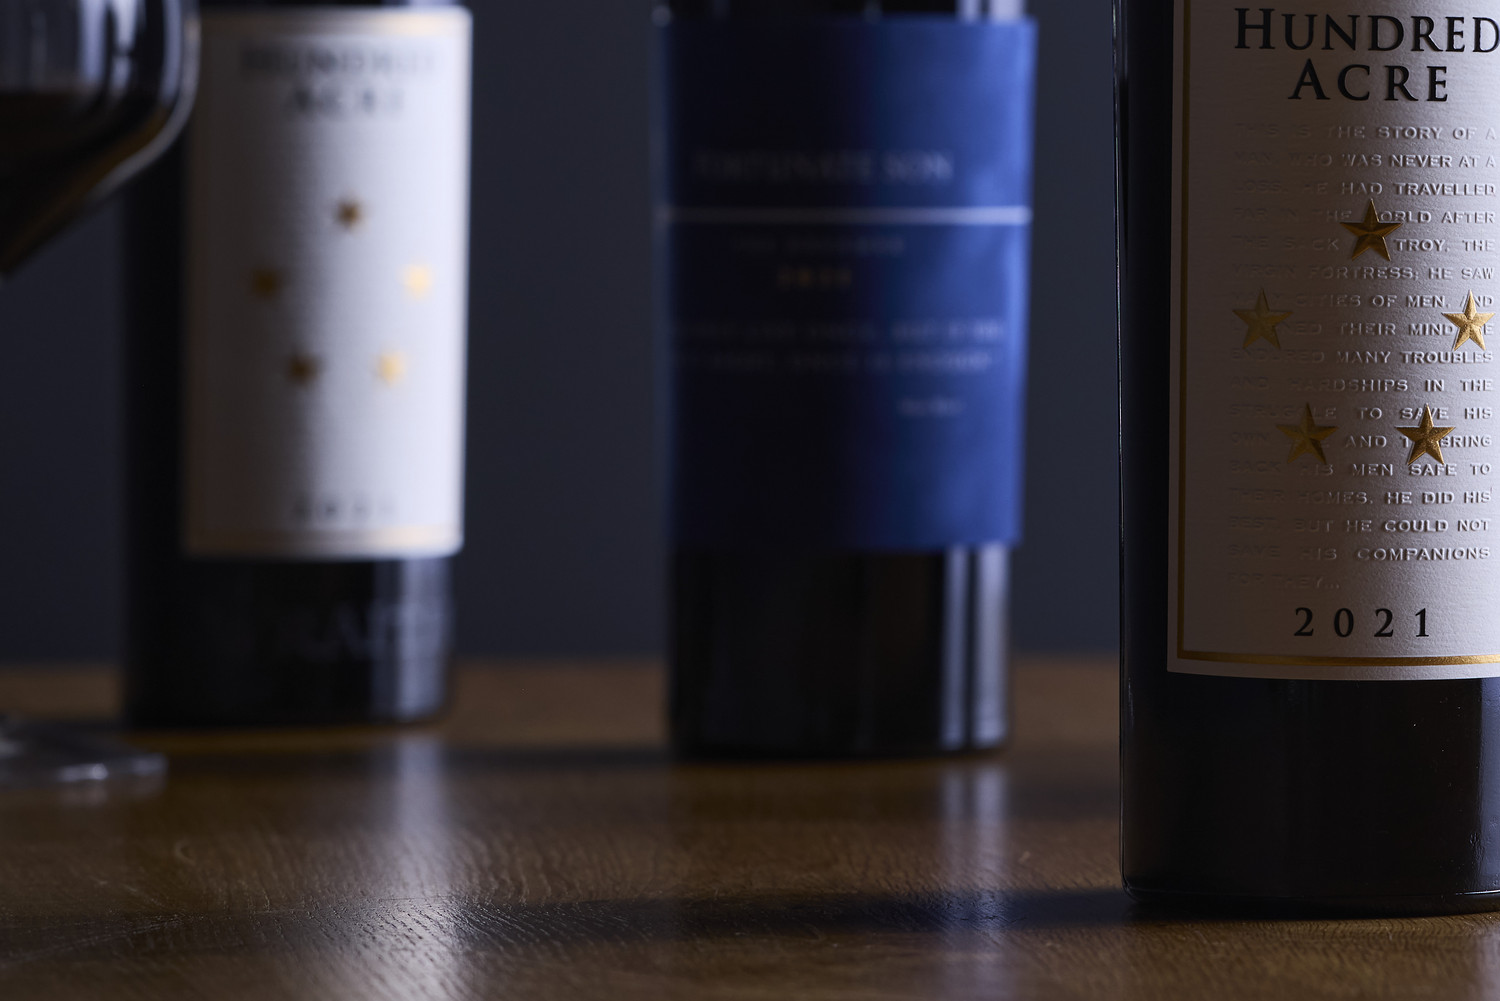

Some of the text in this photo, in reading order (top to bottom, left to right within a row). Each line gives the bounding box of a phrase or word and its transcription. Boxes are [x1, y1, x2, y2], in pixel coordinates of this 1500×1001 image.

[1287, 58, 1448, 102] ACRE
[1328, 126, 1365, 139] THE
[1377, 126, 1443, 139] STORY
[1452, 127, 1477, 140] OF
[1486, 127, 1497, 140] A
[1342, 154, 1382, 167] WAS
[1389, 154, 1452, 167] NEVER
[1459, 155, 1479, 168] AT
[1485, 155, 1496, 168] A
[1342, 182, 1382, 195] HAD
[1393, 183, 1496, 197] TRAVELLED
[1377, 211, 1432, 224] ORLD
[1442, 211, 1496, 224] AFTER
[1462, 239, 1496, 252] THE
[1428, 267, 1452, 279] HE
[1461, 267, 1495, 280] SAW
[1372, 295, 1397, 307] OF
[1339, 323, 1396, 336] THEIR
[1408, 324, 1453, 336] MIND
[1336, 351, 1391, 363] MANY
[1401, 351, 1493, 364] TROUBLES
[1288, 377, 1409, 392] HARDSHIPS
[1425, 379, 1445, 392] IN
[1460, 379, 1493, 392] THE
[1358, 407, 1383, 420] TO
[1465, 407, 1492, 420] HIS
[1345, 435, 1387, 448] AND
[1353, 464, 1394, 476] MEN
[1409, 464, 1457, 476] SAFE
[1470, 464, 1491, 476] TO
[1387, 492, 1413, 504] HE
[1422, 492, 1455, 504] DID
[1464, 492, 1491, 504] HIS
[1346, 519, 1372, 532] HE
[1384, 519, 1448, 533] COULD
[1457, 519, 1491, 532] NOT
[1357, 548, 1491, 561] COMPANIONS
[1294, 607, 1429, 638] 2021
